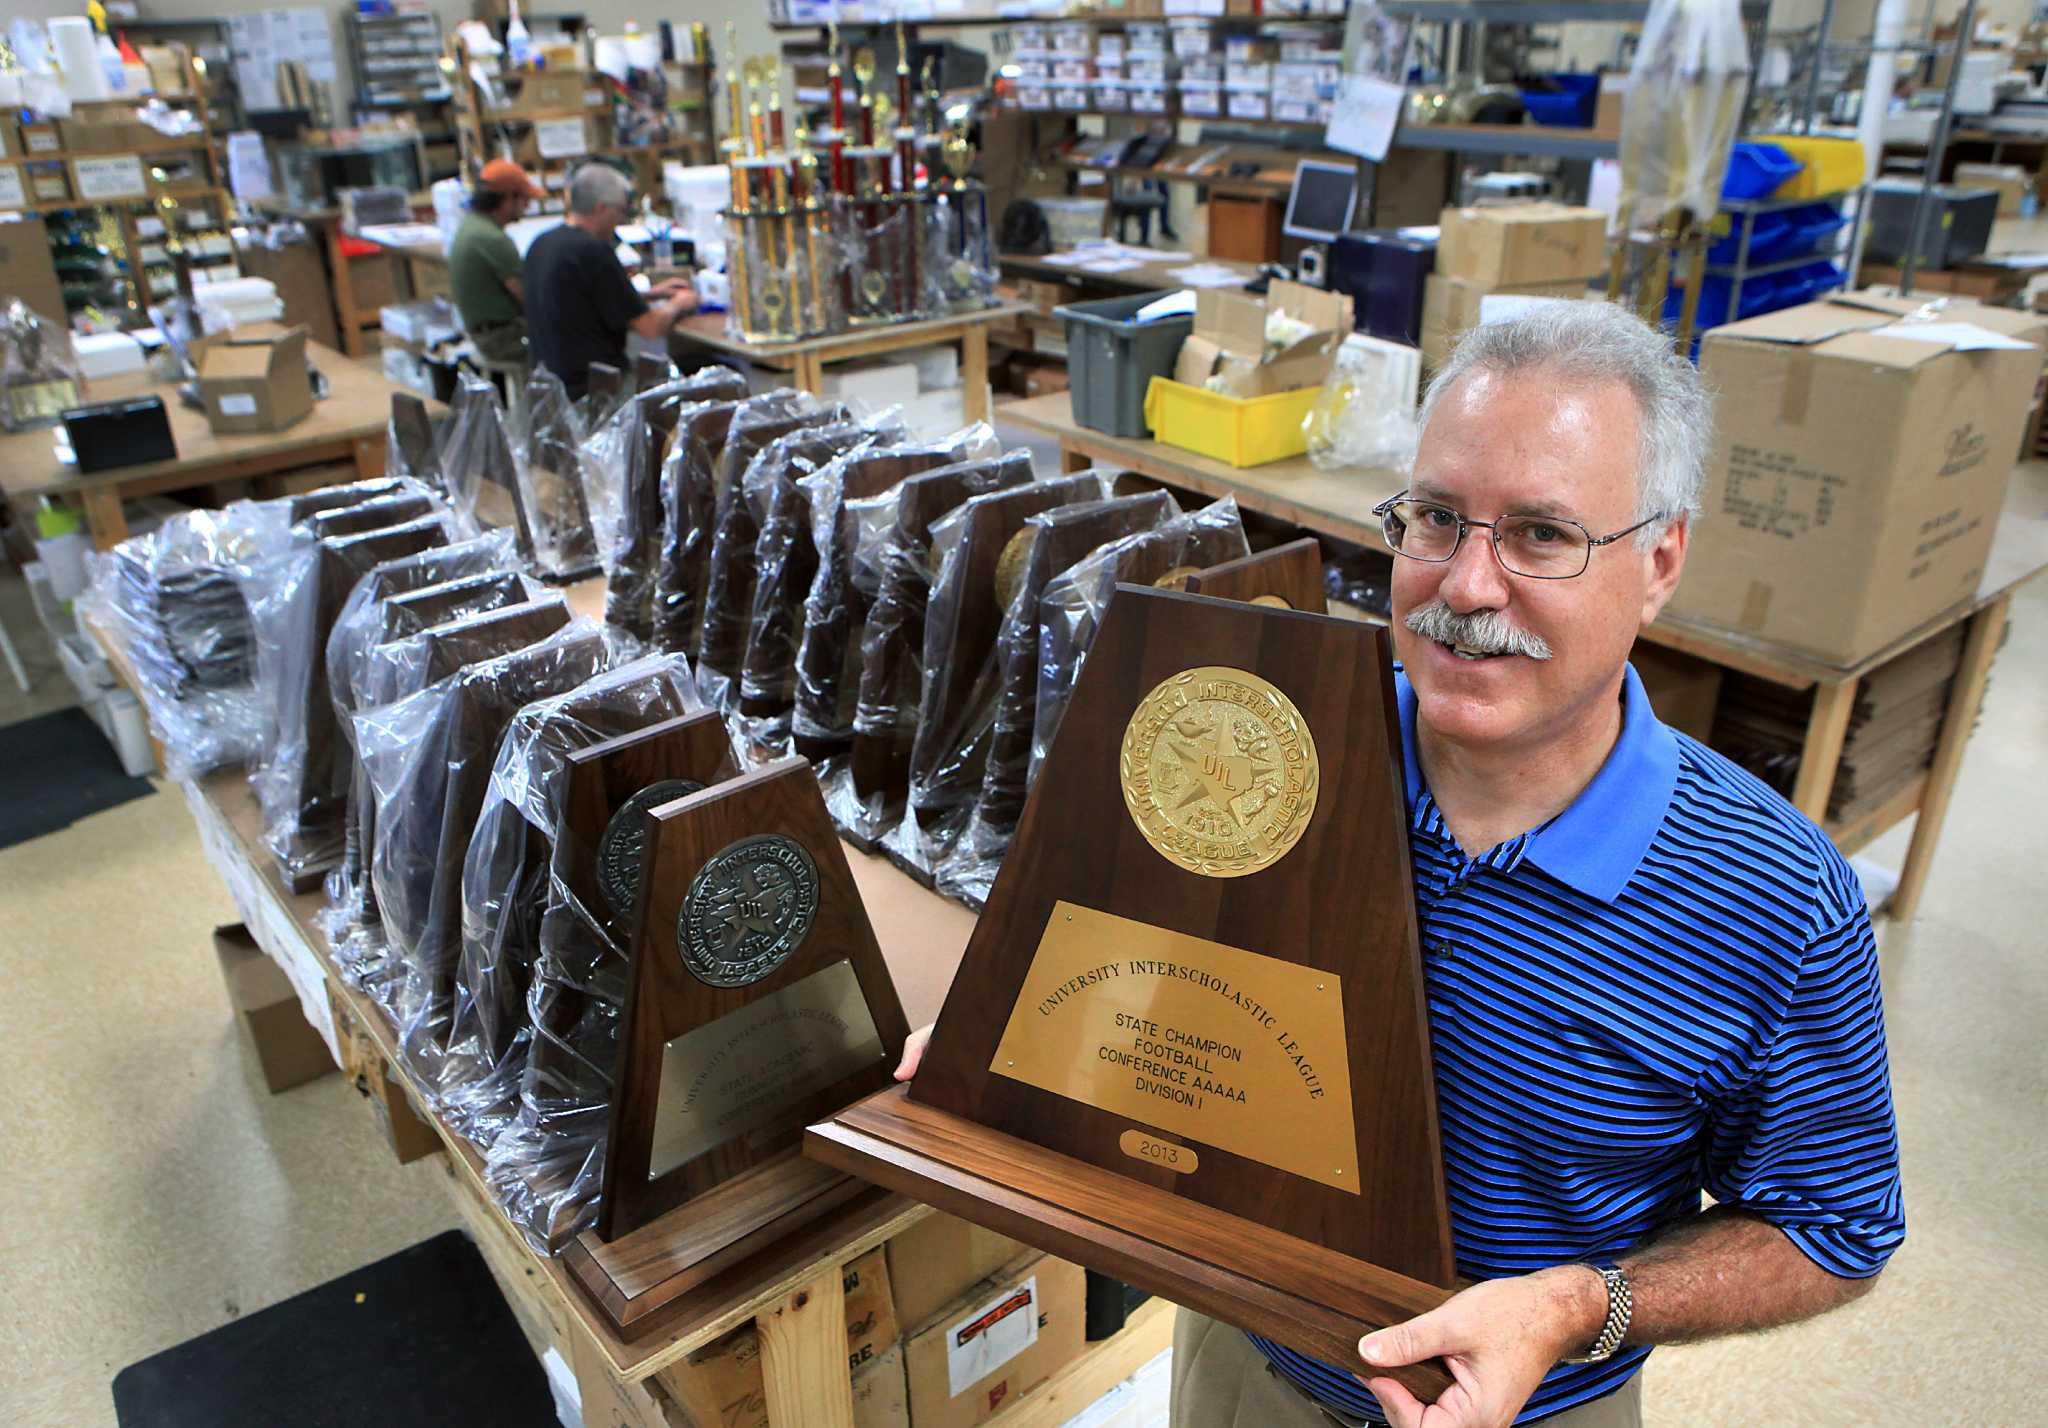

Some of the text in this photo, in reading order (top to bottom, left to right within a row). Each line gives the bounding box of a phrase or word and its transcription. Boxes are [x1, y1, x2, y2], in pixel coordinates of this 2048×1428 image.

[1199, 683, 1303, 840] INTERSCHOLASTIC
[1203, 754, 1235, 791] UIL
[1162, 824, 1258, 859] LEAGUE
[739, 901, 769, 919] UIL
[1038, 961, 1324, 1100] UNIVERSITY INTERSCHOLASTIC LEAGUE
[1115, 1013, 1242, 1062] STATE CHAMPION
[1134, 1039, 1214, 1074] FOOTBALL
[1099, 1046, 1247, 1104] CONFERENCE AAAAA
[1135, 1078, 1194, 1106] DIVISION
[1139, 1140, 1179, 1164] 2013
